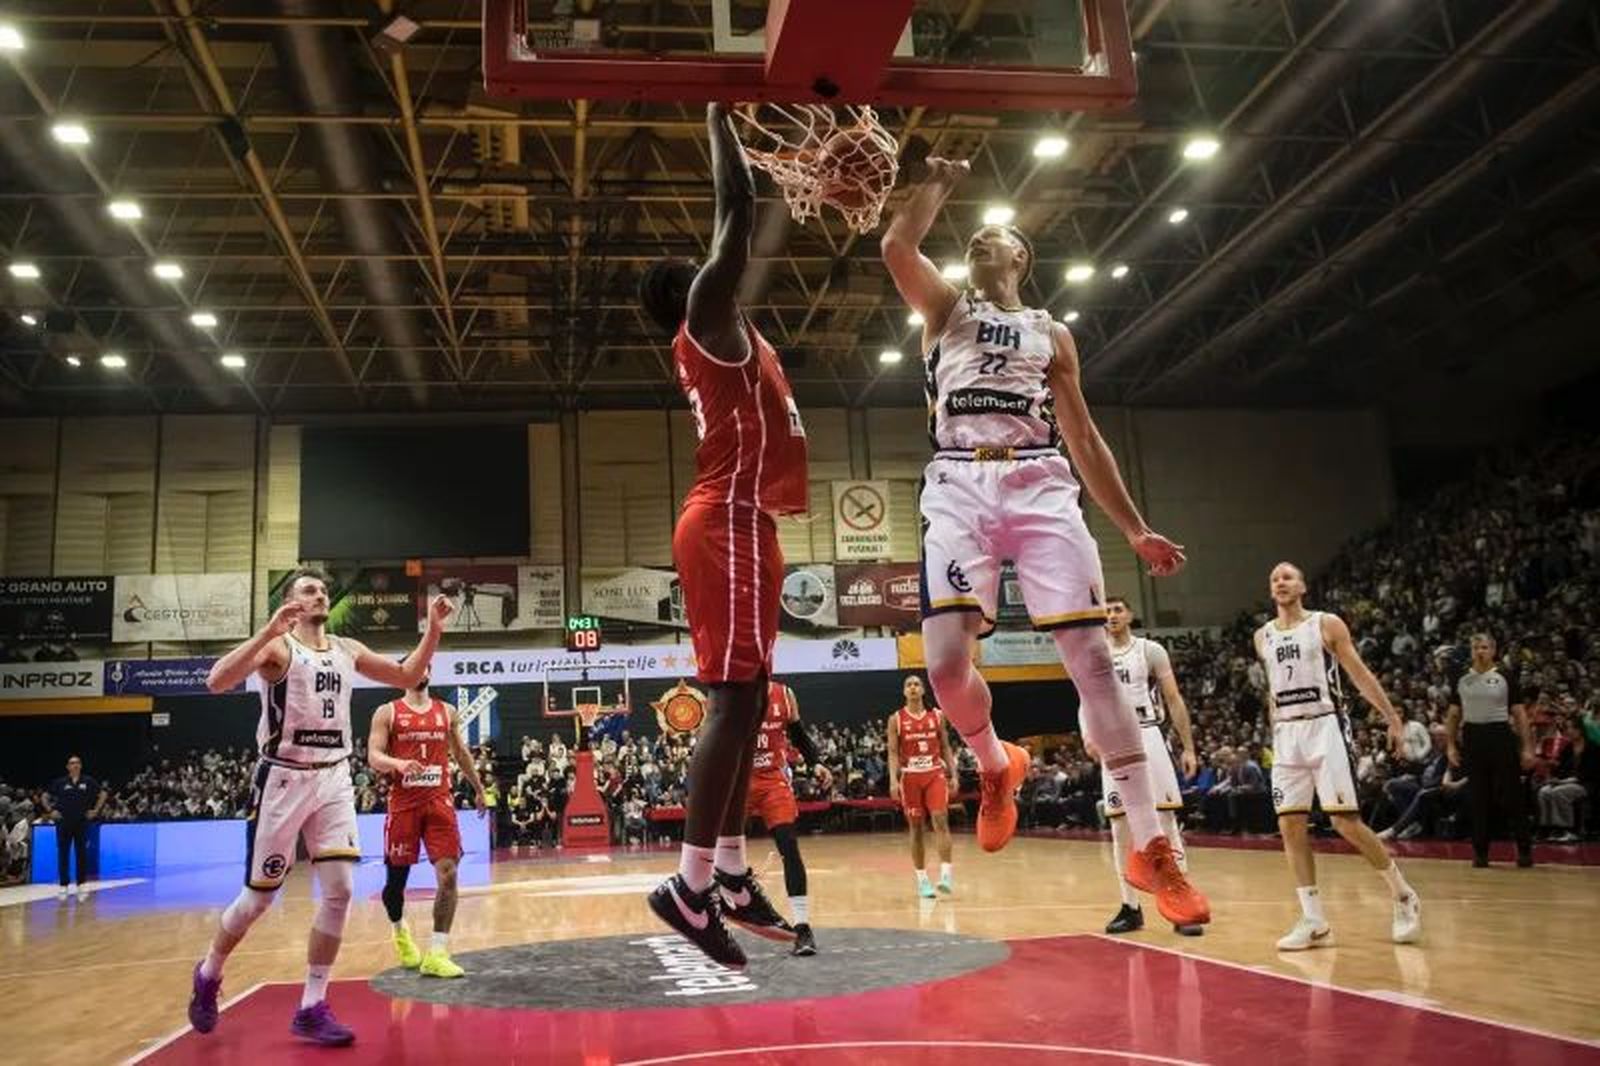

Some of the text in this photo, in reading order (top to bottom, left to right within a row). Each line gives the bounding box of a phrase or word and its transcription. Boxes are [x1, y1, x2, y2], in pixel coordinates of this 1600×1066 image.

[975, 321, 1020, 350] BIH
[979, 352, 1008, 376] 22
[8, 582, 63, 593] GRAND
[65, 581, 108, 592] AUTO
[575, 631, 597, 647] 08
[1276, 644, 1301, 663] BIH
[454, 661, 505, 675] SRCA
[1286, 664, 1293, 681] 7
[3, 672, 93, 689] INPROZ
[314, 672, 341, 693] BIH
[322, 700, 335, 718] 19
[420, 743, 427, 758] 1
